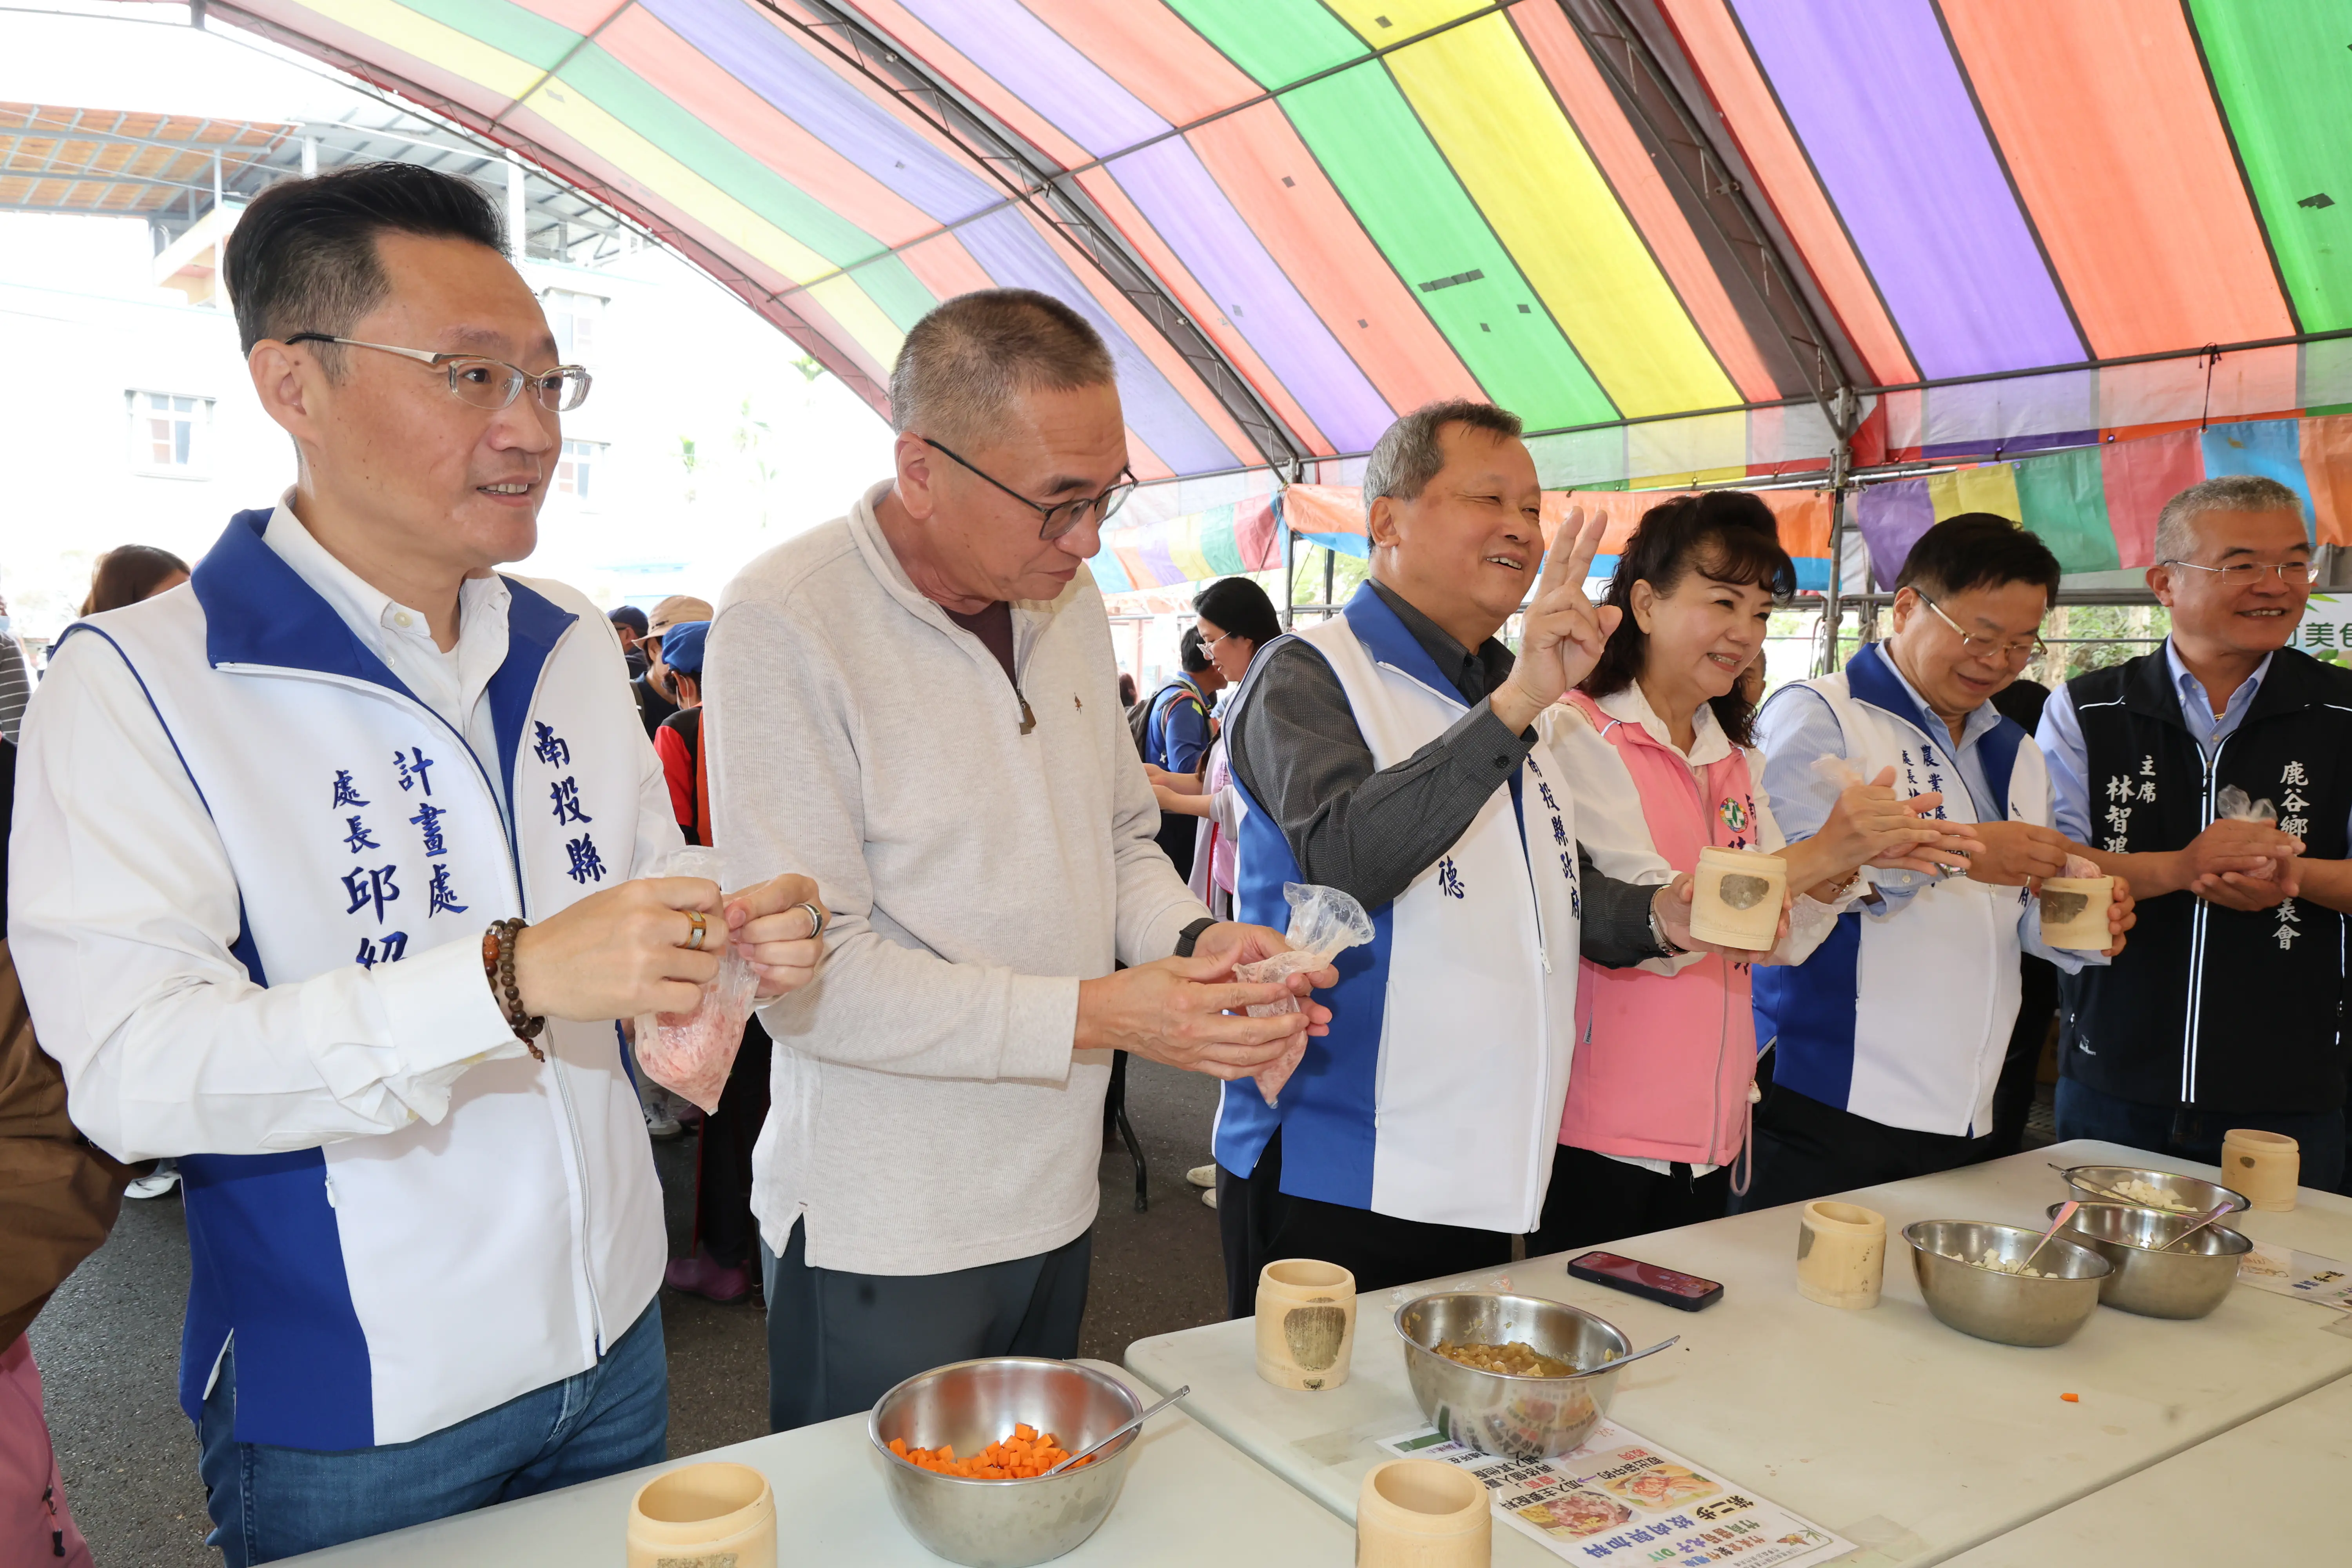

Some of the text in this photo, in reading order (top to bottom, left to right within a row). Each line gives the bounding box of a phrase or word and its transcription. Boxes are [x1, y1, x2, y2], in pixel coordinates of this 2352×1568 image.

[2136, 755, 2156, 804] 主席
[534, 720, 607, 884] 南投縣
[2103, 775, 2135, 854] 林智鴻
[393, 747, 469, 918] 計畫處
[1526, 752, 1581, 920] 南投縣政府
[1438, 855, 1465, 899] 德
[1597, 1456, 1665, 1479] 取出袋中的
[1617, 1448, 1649, 1461] 絞肉
[1484, 1463, 1555, 1490] 再依個人喜
[1499, 1479, 1584, 1510] 加入主要配料
[1696, 1495, 1754, 1520] 第二步
[1582, 1515, 1695, 1558] 絞肉與加料
[1647, 1548, 1677, 1562] DIY
